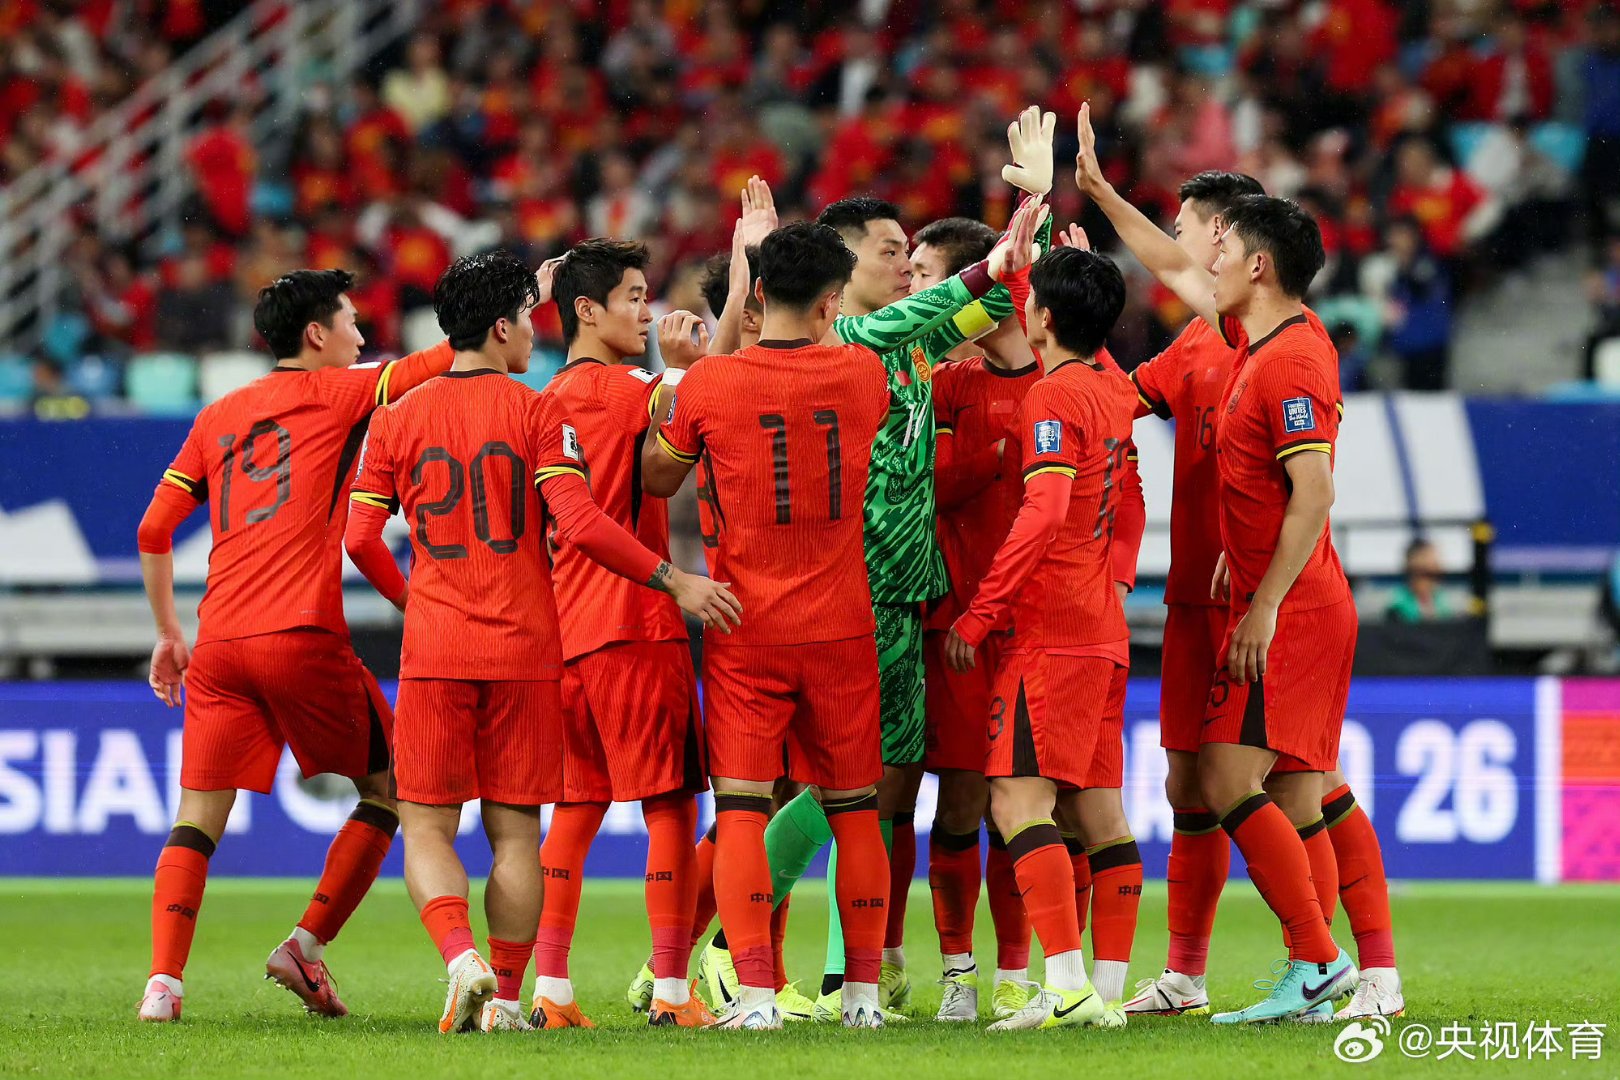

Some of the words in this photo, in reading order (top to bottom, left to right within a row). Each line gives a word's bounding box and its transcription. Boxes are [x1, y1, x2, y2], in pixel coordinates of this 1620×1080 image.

[218, 419, 291, 532] 19
[759, 409, 842, 524] 11
[1194, 406, 1215, 449] 16
[410, 441, 526, 560] 20
[1396, 719, 1518, 843] 26
[166, 903, 195, 920] 中国
[851, 898, 884, 908] 中国
